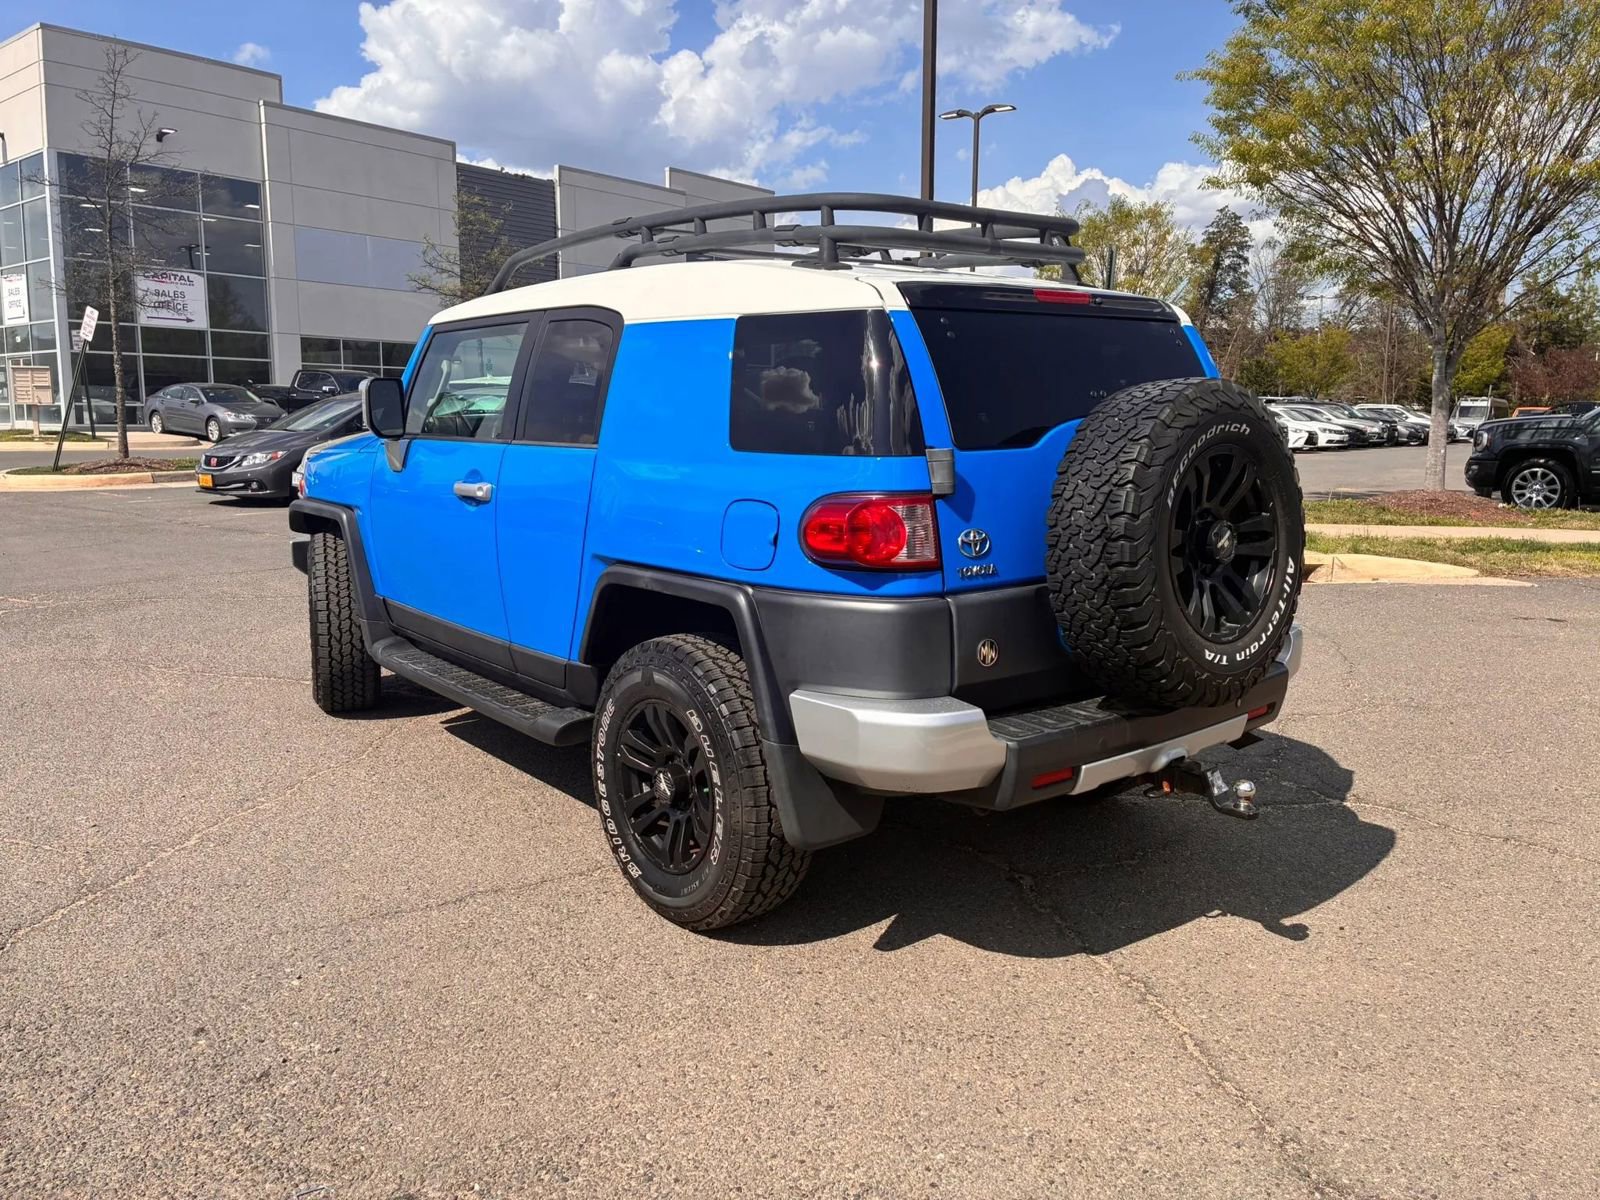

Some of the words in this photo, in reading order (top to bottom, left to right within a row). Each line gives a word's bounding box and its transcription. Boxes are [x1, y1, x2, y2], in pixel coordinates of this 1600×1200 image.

[144, 271, 194, 283] CAPITAL
[8, 287, 20, 296] SALES
[153, 288, 186, 299] SALES
[8, 299, 22, 309] OFFICE
[153, 301, 189, 312] OFFICE
[1167, 421, 1251, 509] BFGoodrich
[957, 563, 997, 578] TOYOTA
[1204, 649, 1229, 665] T/A
[596, 698, 642, 879] BRIDGESTONE
[686, 709, 724, 866] DUELER
